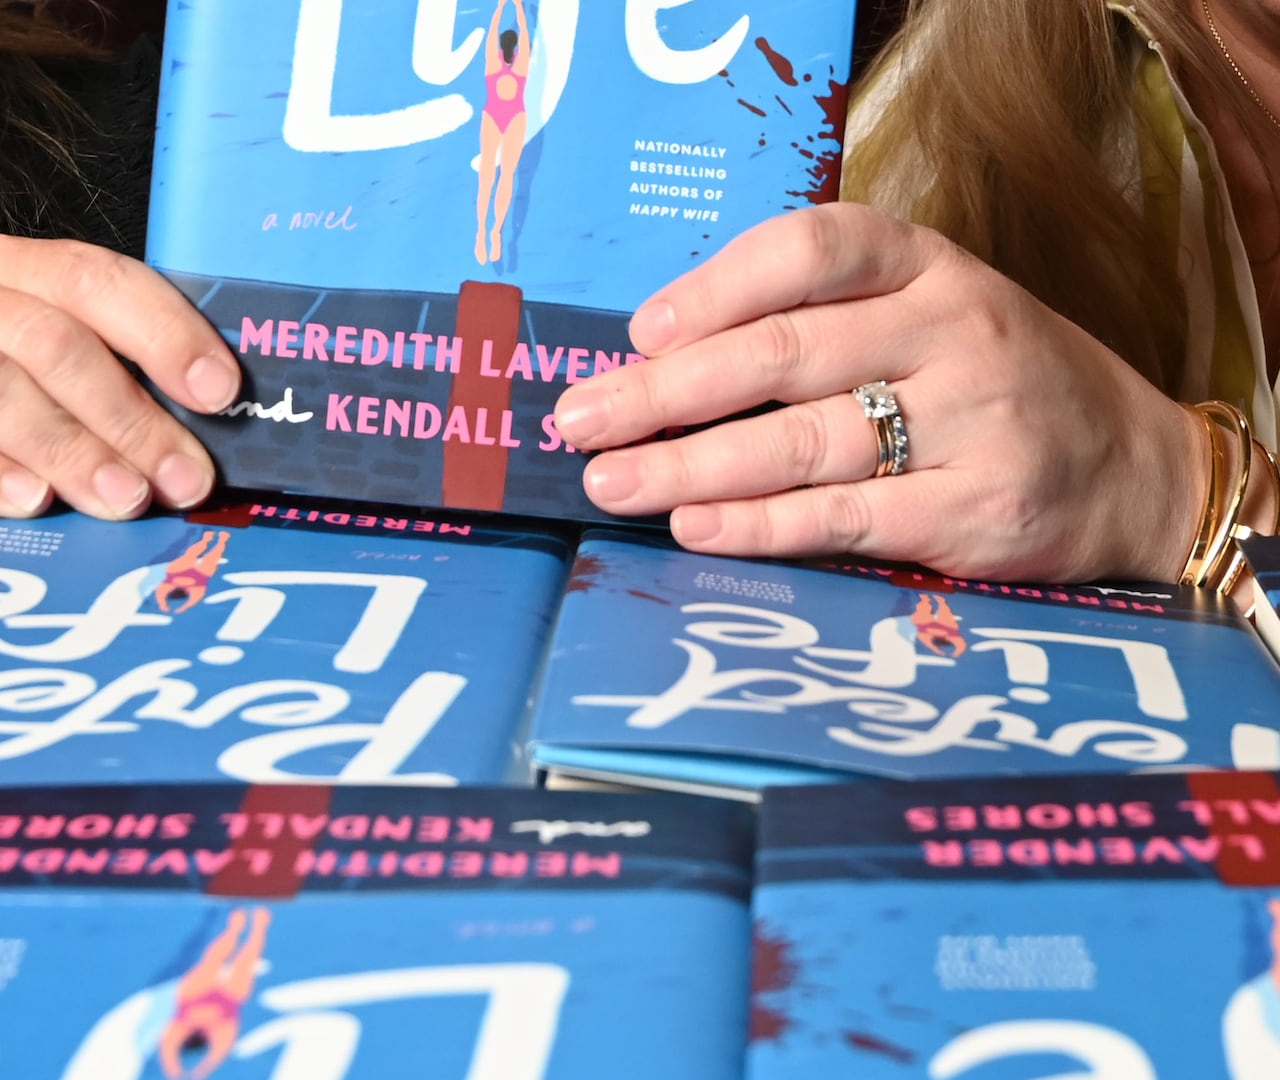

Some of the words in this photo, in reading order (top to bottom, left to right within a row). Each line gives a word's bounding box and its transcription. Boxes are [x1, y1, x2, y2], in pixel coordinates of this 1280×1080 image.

[634, 139, 727, 159] NATIONALLY
[629, 160, 728, 180] BESTSELLING
[629, 181, 699, 200] AUTHORS
[703, 189, 724, 201] OF
[261, 213, 279, 232] a
[288, 204, 358, 233] novel
[629, 203, 680, 218] HAPPY
[683, 208, 720, 223] WIFE
[239, 316, 463, 375] MEREDITH
[326, 393, 521, 449] KENDALL
[248, 503, 474, 537] MEREDITH
[680, 602, 1189, 721] Life
[219, 813, 495, 842] KENDALL
[904, 800, 1155, 832] SHORES
[293, 850, 622, 878] MEREDITH
[921, 834, 1266, 867] LAVENDER
